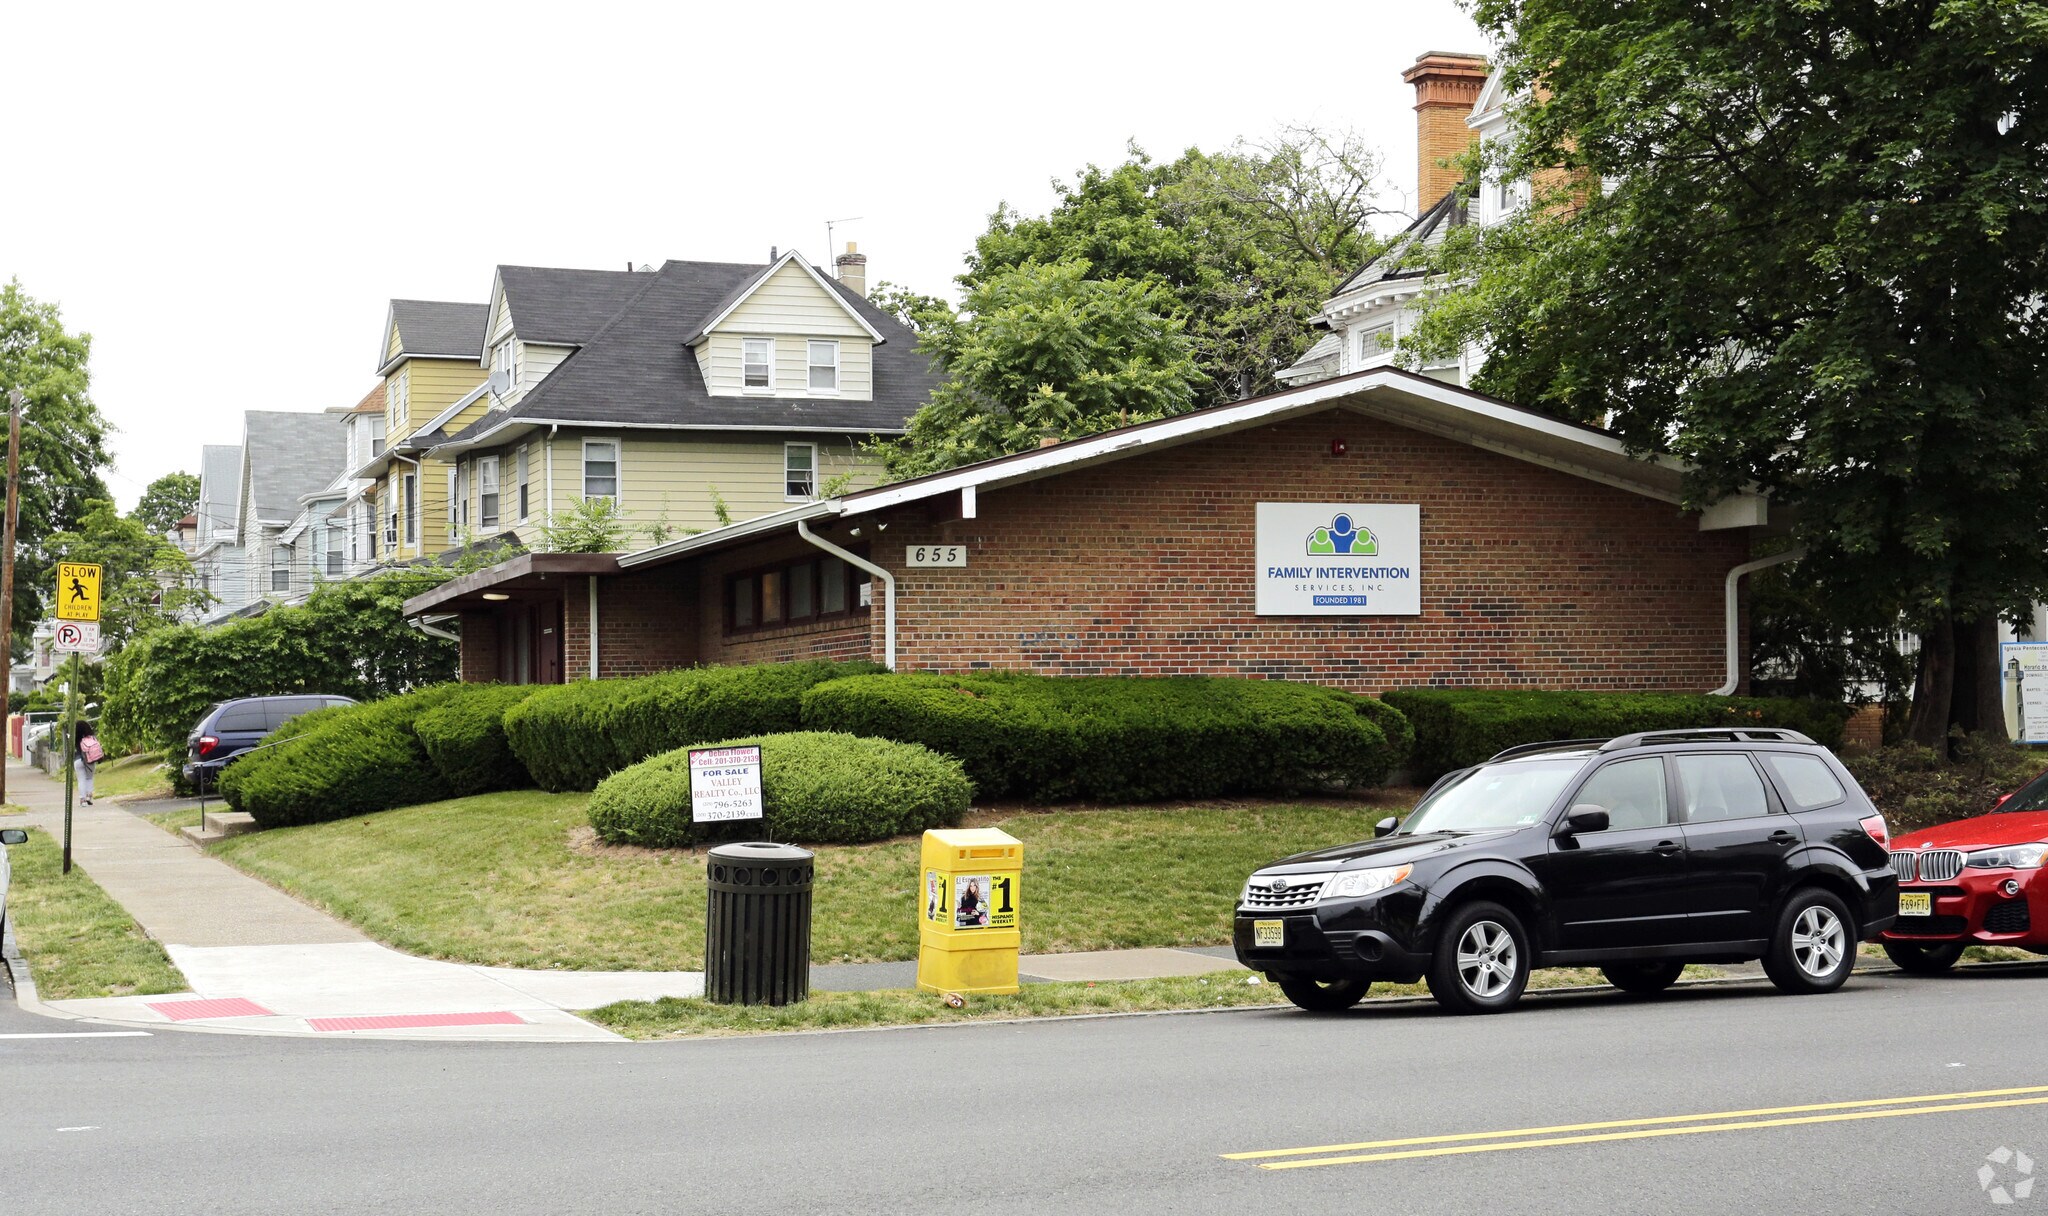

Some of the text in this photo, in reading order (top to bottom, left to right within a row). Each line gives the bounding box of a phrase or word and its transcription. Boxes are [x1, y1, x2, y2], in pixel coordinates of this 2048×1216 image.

[916, 547, 957, 562] 655
[63, 566, 96, 578] SLOW
[1267, 567, 1410, 579] FAMILY INTERVENTION
[1294, 584, 1385, 593] SERVICES, INC.
[715, 755, 760, 765] 201-370-2139
[703, 768, 749, 777] FOR SALE
[711, 778, 742, 787] VALLEY
[694, 789, 726, 799] REALTY
[744, 787, 760, 795] LLC
[713, 799, 753, 809] 796-5263
[707, 809, 746, 820] 370-2139
